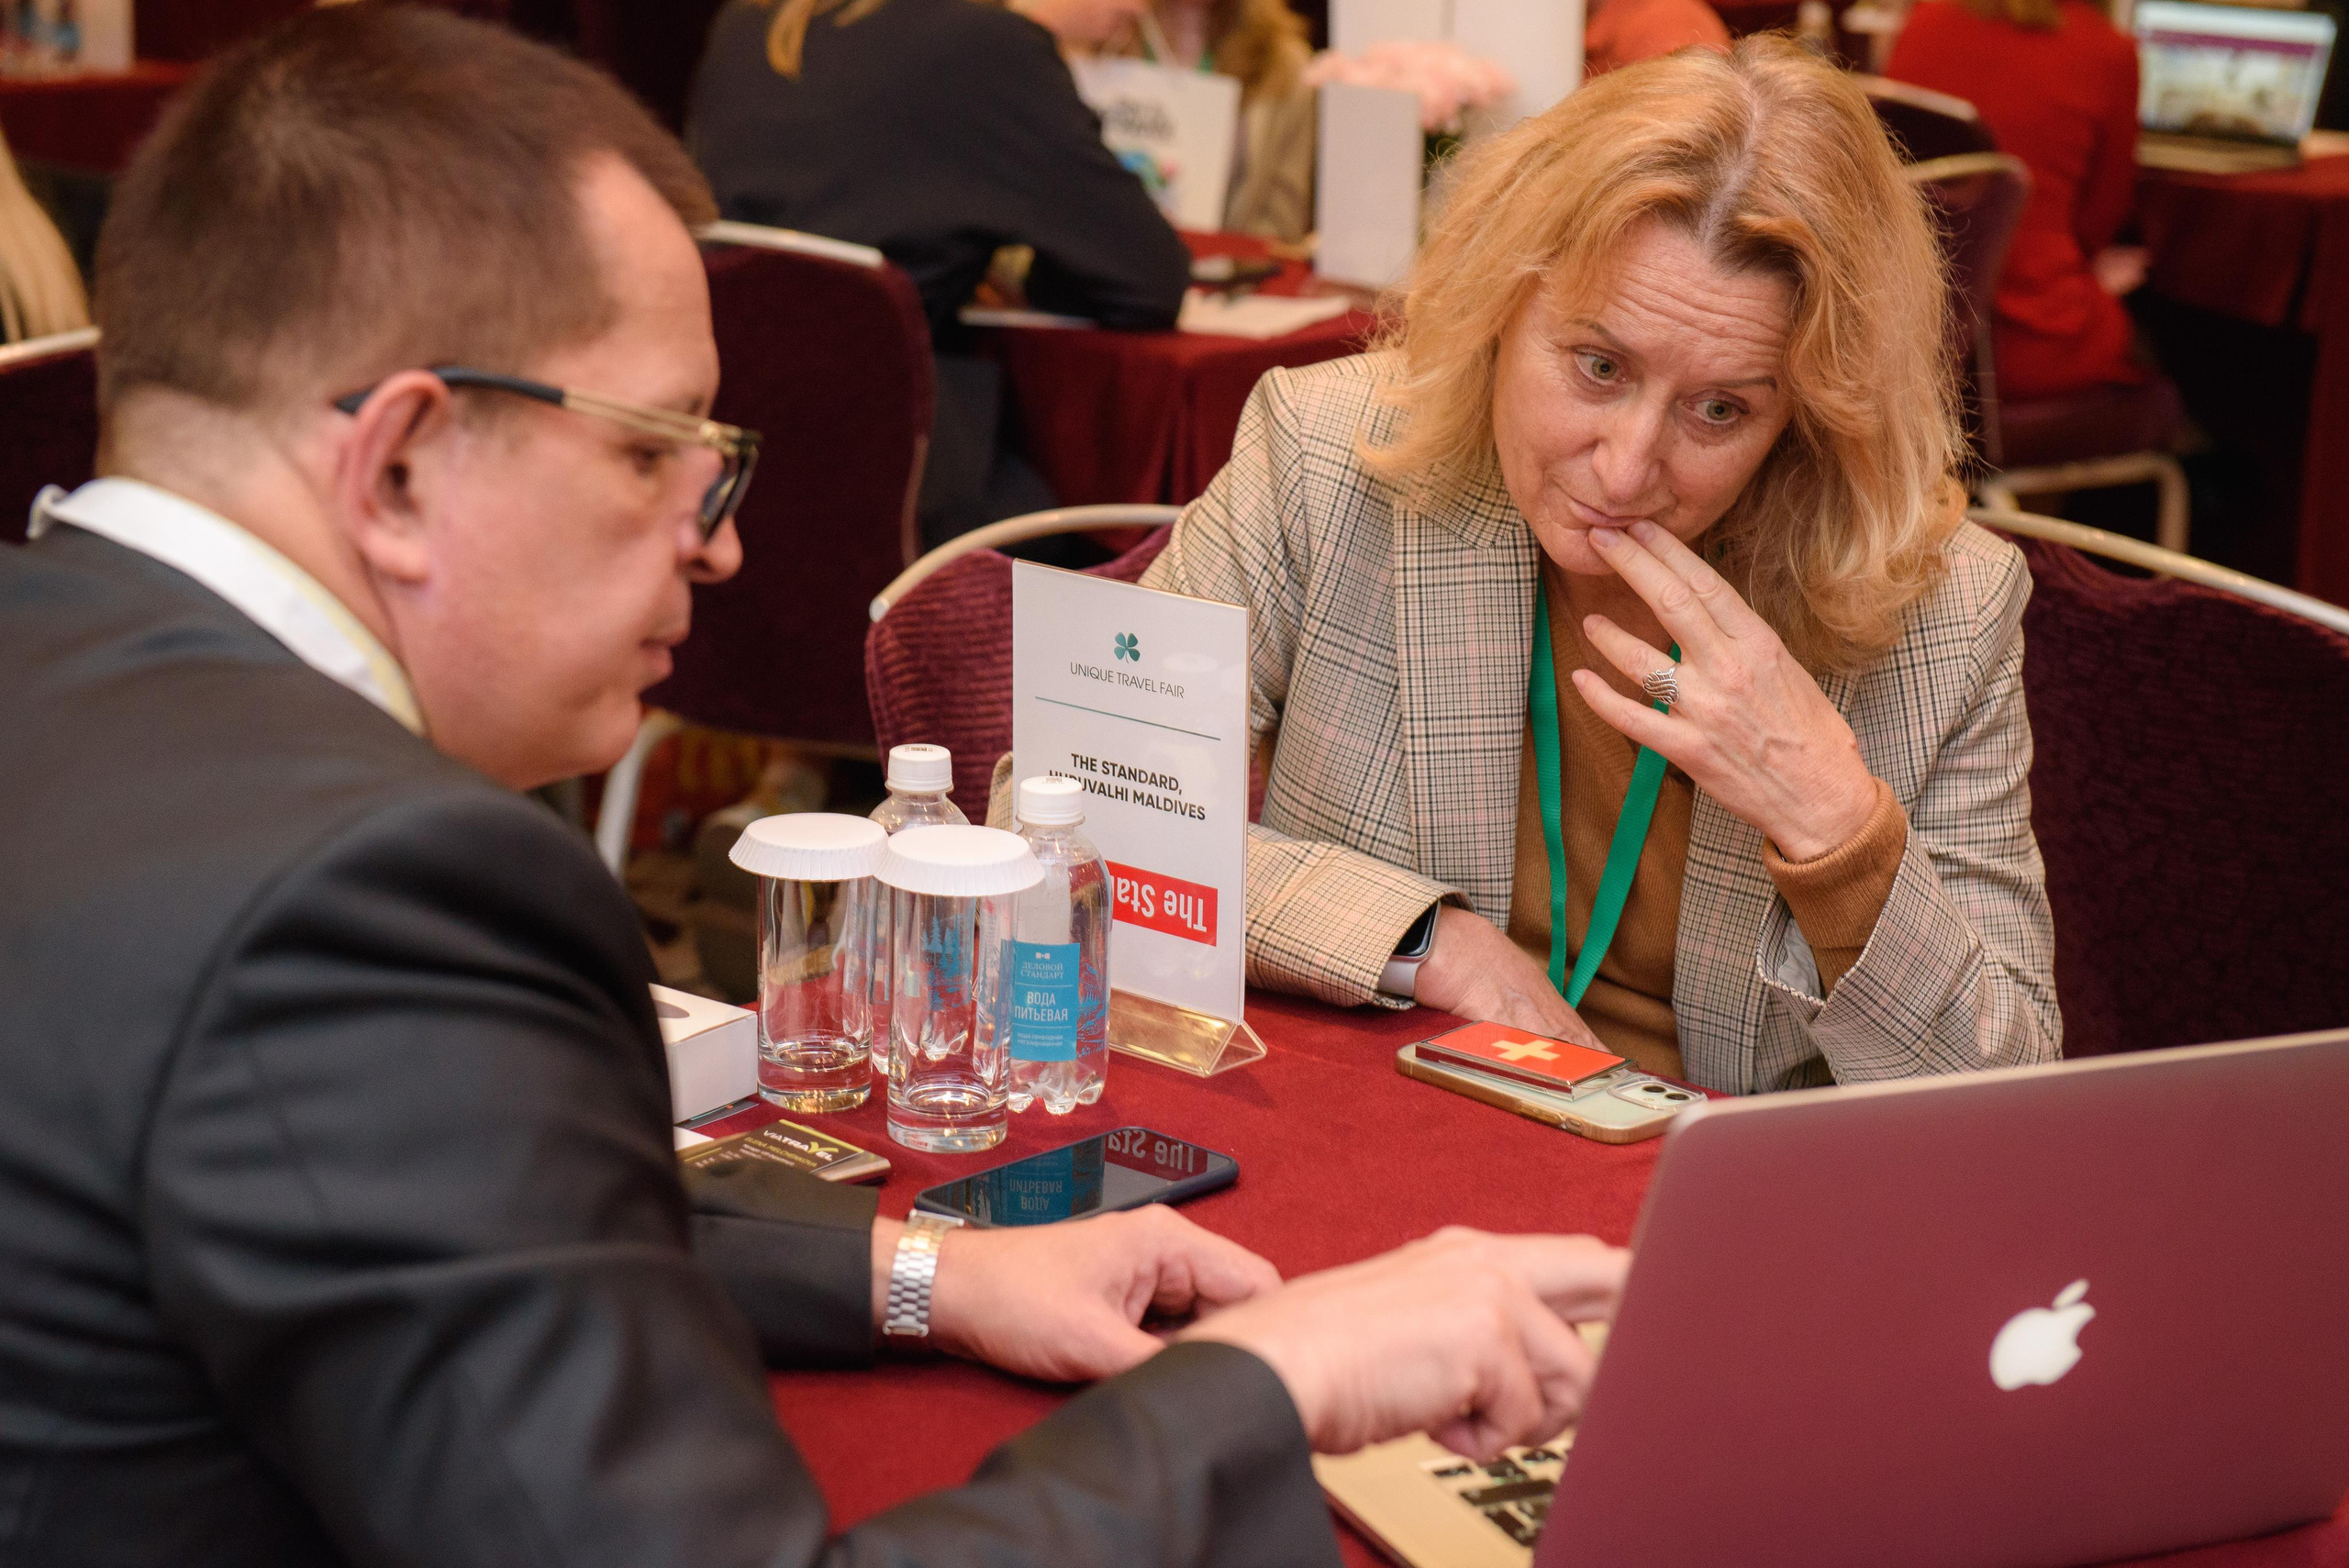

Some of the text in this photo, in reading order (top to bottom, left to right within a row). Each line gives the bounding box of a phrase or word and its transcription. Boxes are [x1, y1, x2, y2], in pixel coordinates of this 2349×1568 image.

[1070, 662, 1185, 698] UNIQUE TRAVEL FAIR
[1071, 752, 1182, 795] THE STANDARD,
[1132, 789, 1206, 820] MALDIVES
[1163, 889, 1208, 932] The
[1020, 969, 1064, 979] СТАНДАРТ
[1021, 961, 1063, 971] ДЕЛОВОЙ
[1027, 991, 1056, 1006] ВОДА
[1014, 1006, 1068, 1021] ПИТЬЕВАЯ
